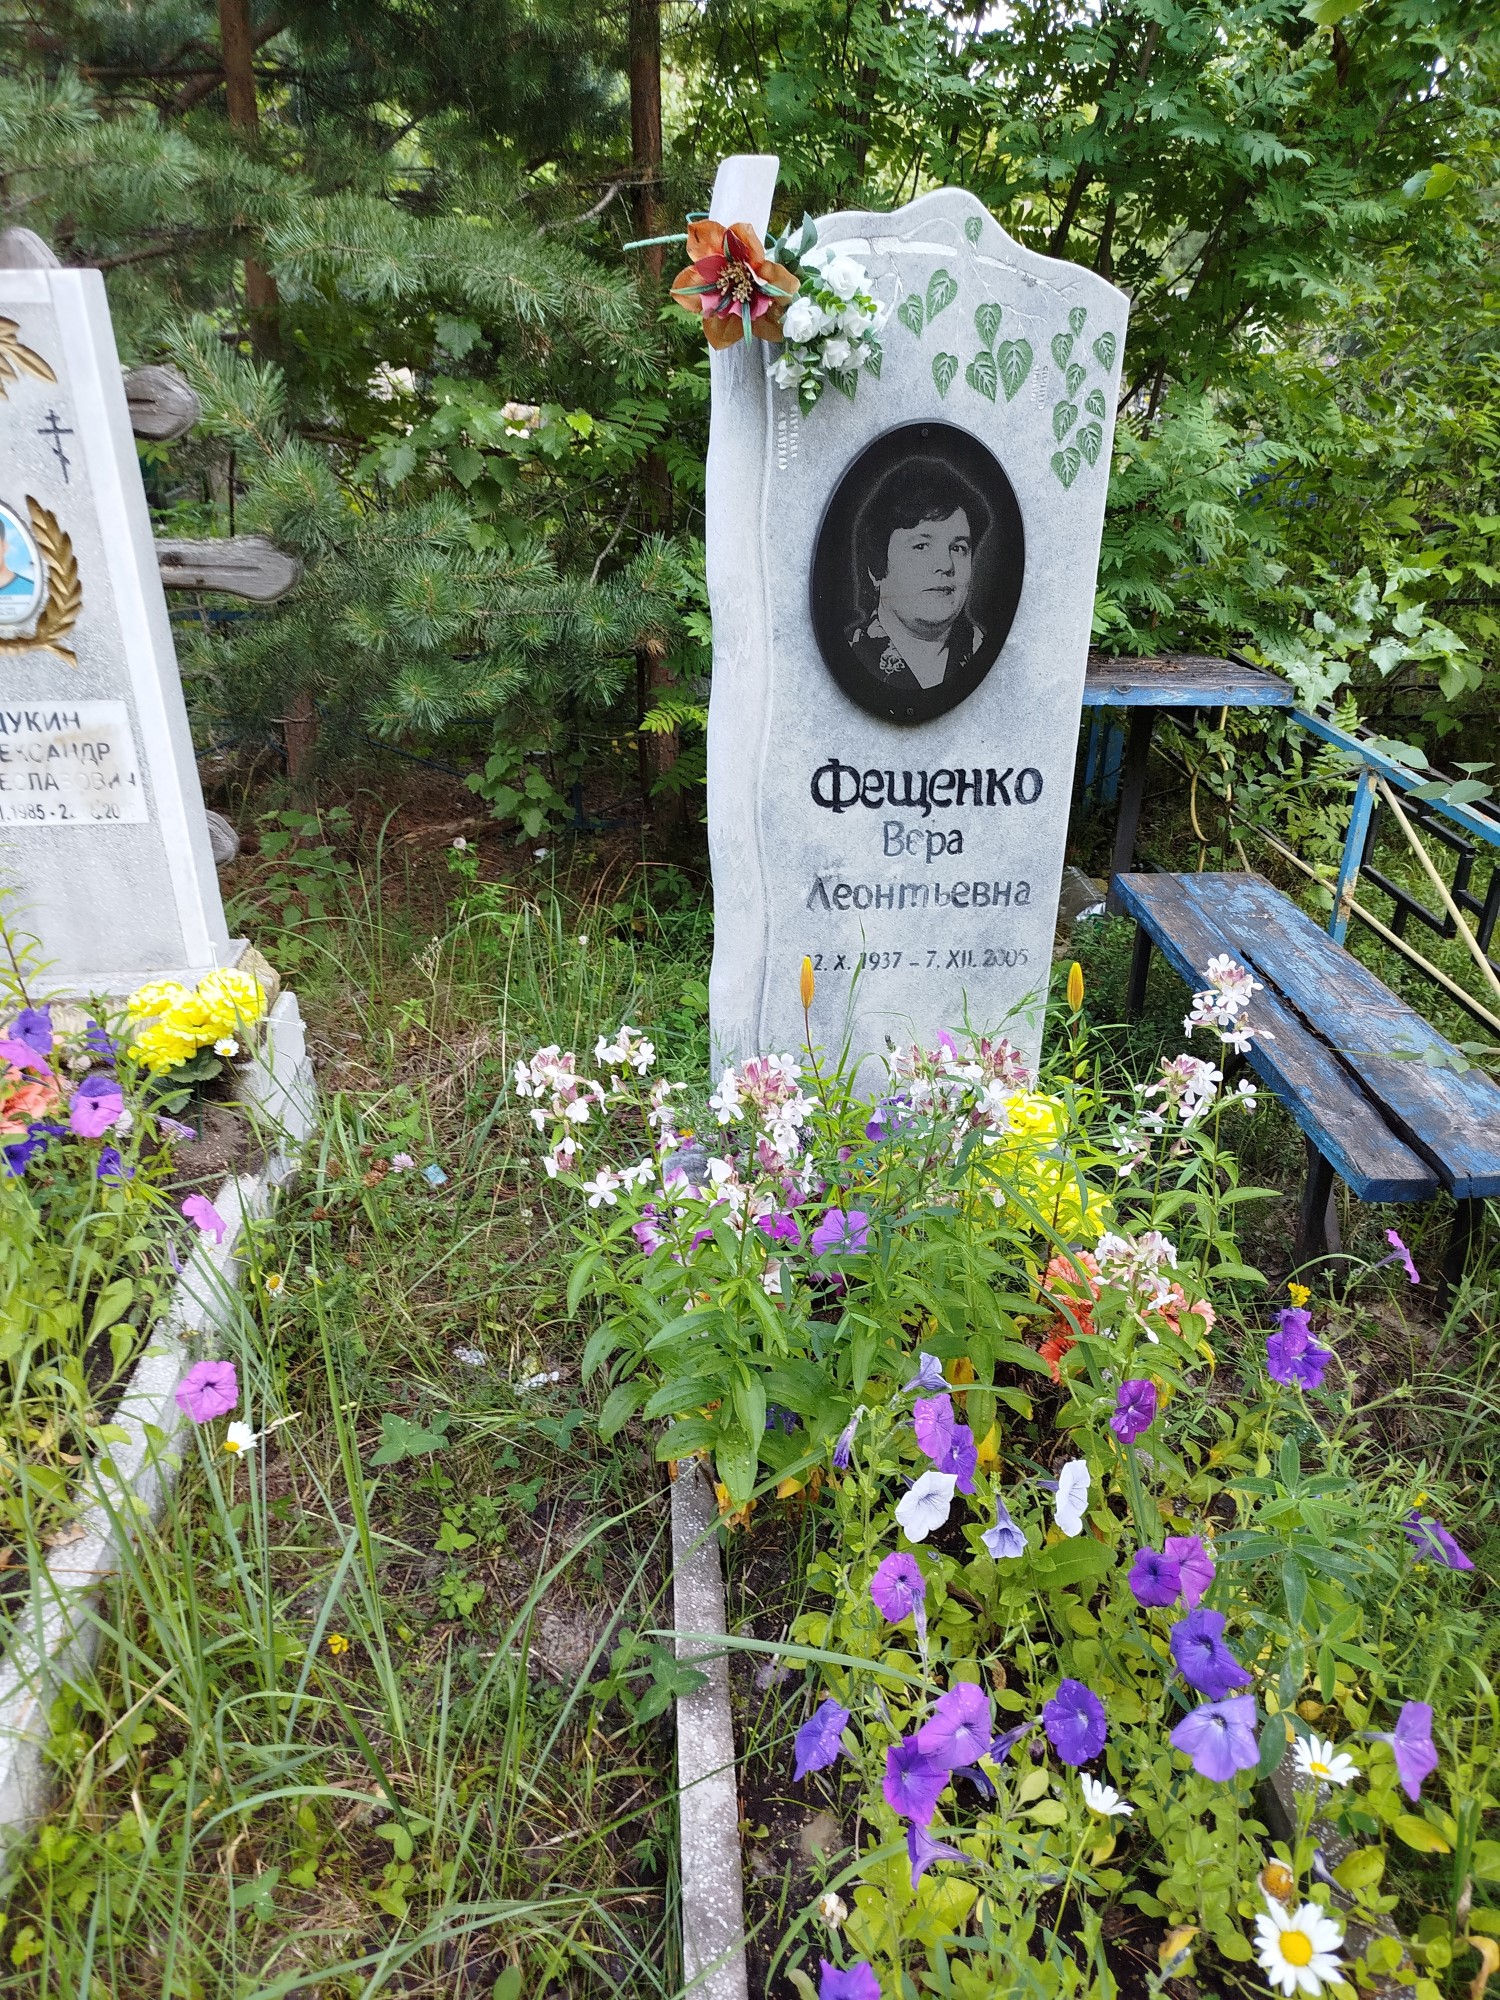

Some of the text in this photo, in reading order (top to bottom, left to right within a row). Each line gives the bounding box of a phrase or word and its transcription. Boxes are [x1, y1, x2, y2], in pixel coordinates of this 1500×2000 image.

[810, 758, 1044, 817] Фещенко
[883, 820, 963, 864] Вера
[806, 877, 1031, 911] Леонтьевна
[804, 954, 828, 971] 2.
[860, 951, 903, 971] 1937
[982, 948, 1028, 968] 2005
